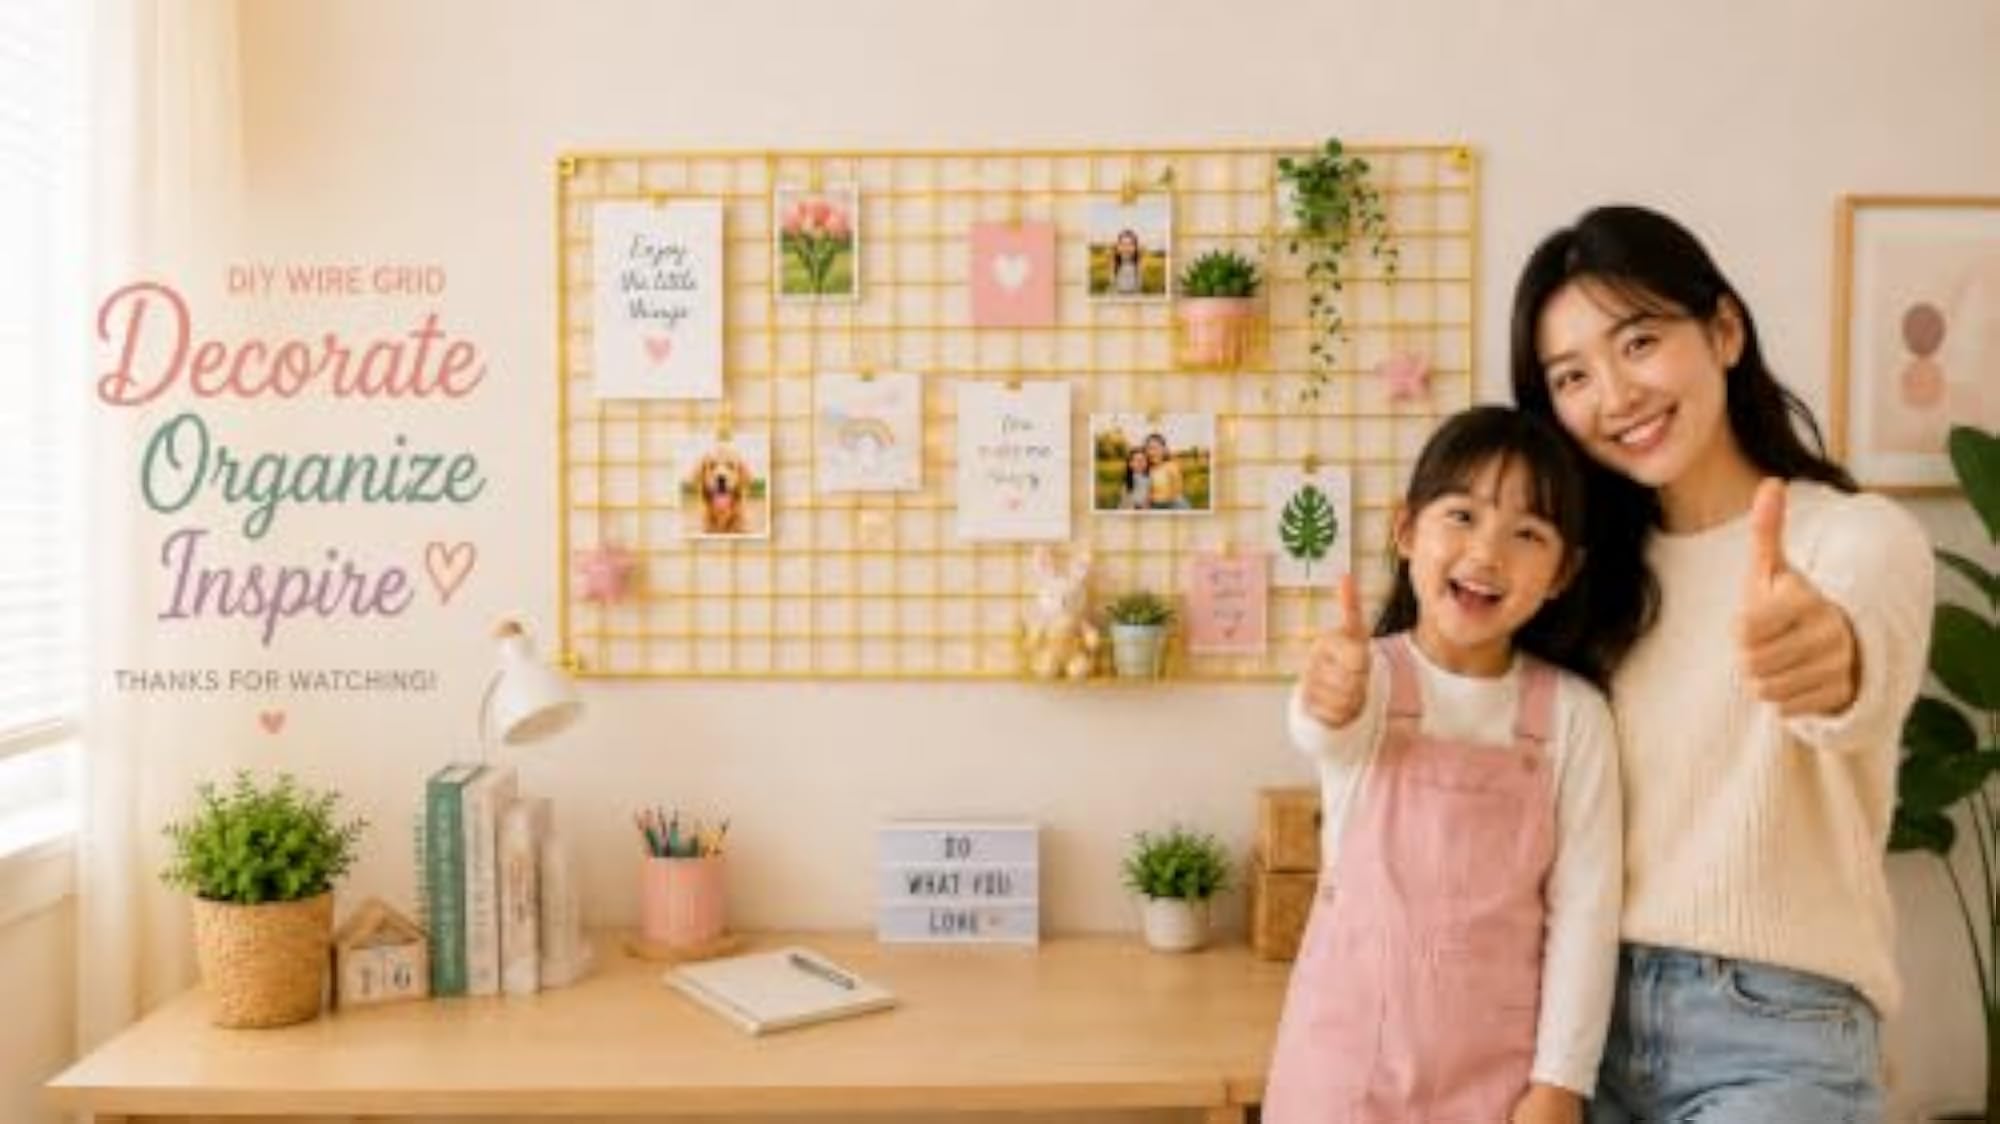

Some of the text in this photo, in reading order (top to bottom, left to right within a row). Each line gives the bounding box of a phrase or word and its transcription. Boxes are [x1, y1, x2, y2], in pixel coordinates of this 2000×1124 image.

[629, 234, 686, 267] Enjoy
[907, 870, 1012, 895] WHAT YOU
